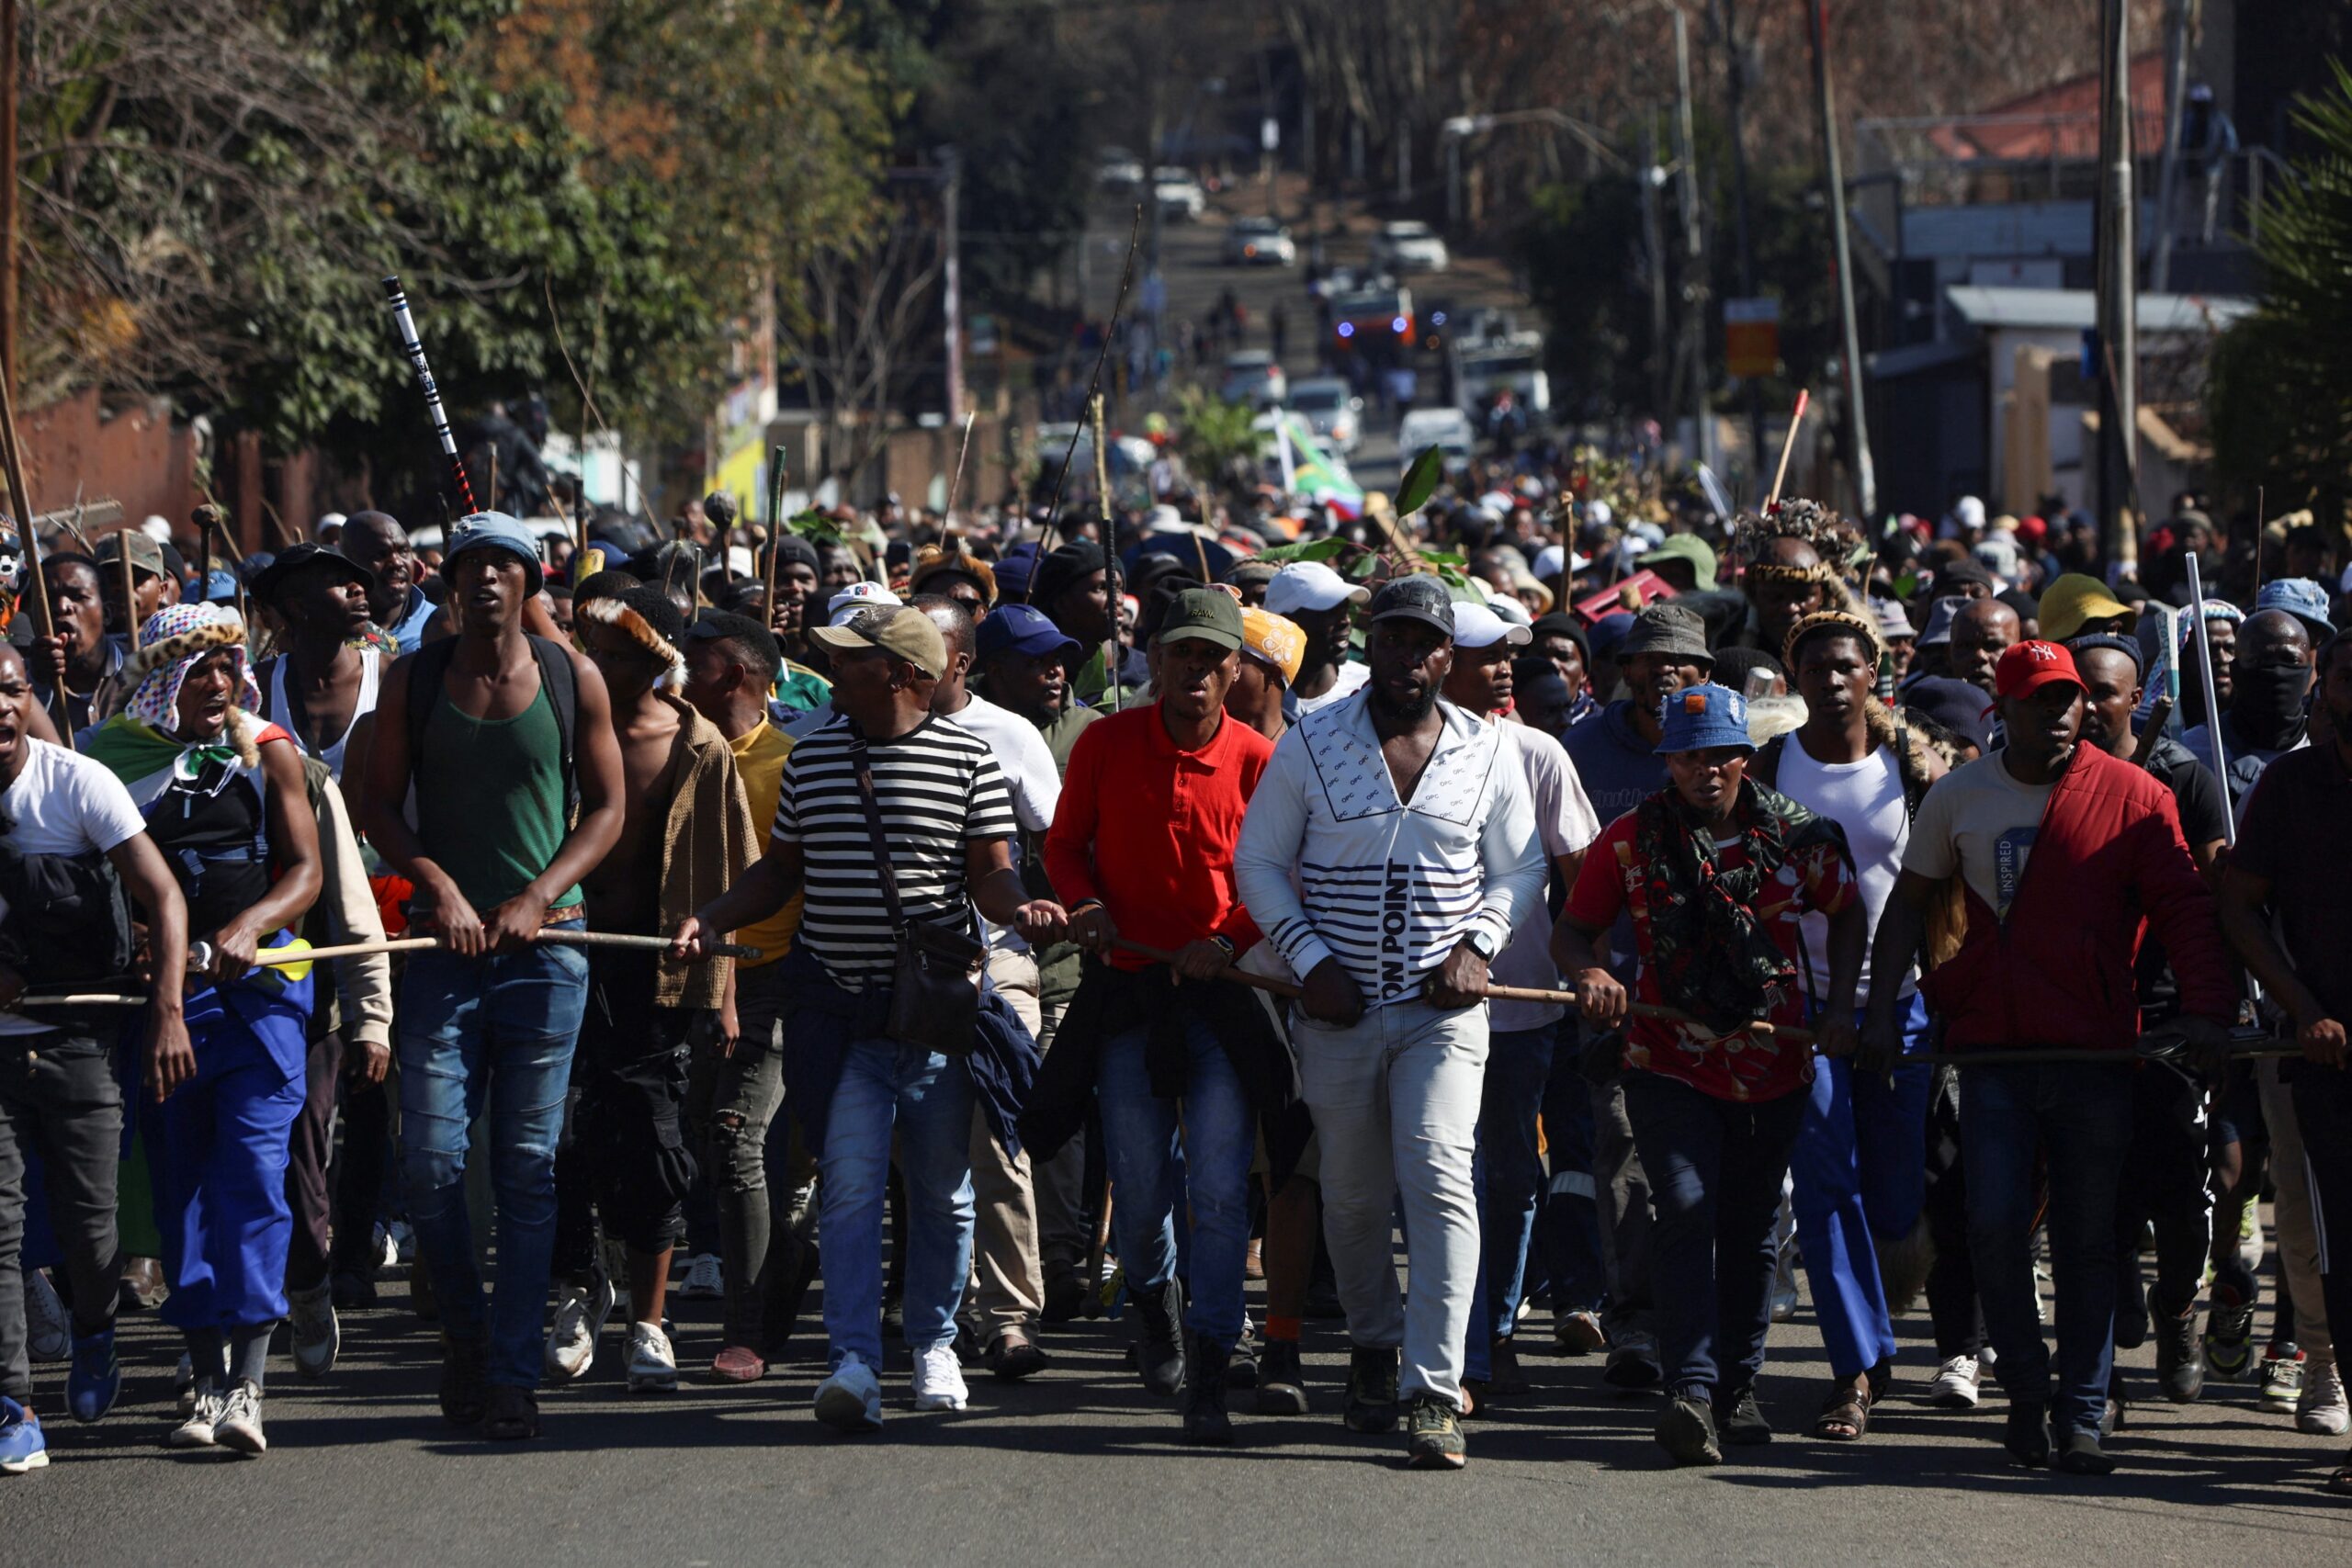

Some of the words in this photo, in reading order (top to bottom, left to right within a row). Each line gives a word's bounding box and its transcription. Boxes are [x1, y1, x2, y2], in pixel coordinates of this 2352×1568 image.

[2030, 644, 2057, 661] NY
[1305, 731, 1317, 741] OPC
[1329, 728, 1341, 737] OPC
[1319, 745, 1331, 756] OPC
[1343, 740, 1354, 751] OPC
[1334, 761, 1347, 771] OPC
[1328, 777, 1340, 788] OPC
[1351, 775, 1363, 785] OPC
[1341, 793, 1354, 803] OPC
[1366, 789, 1379, 800] OPC
[1359, 807, 1372, 818] OPC
[1999, 840, 2015, 892] INSPIRED
[1381, 857, 1409, 954] POINT
[1381, 961, 1405, 1001] ON
